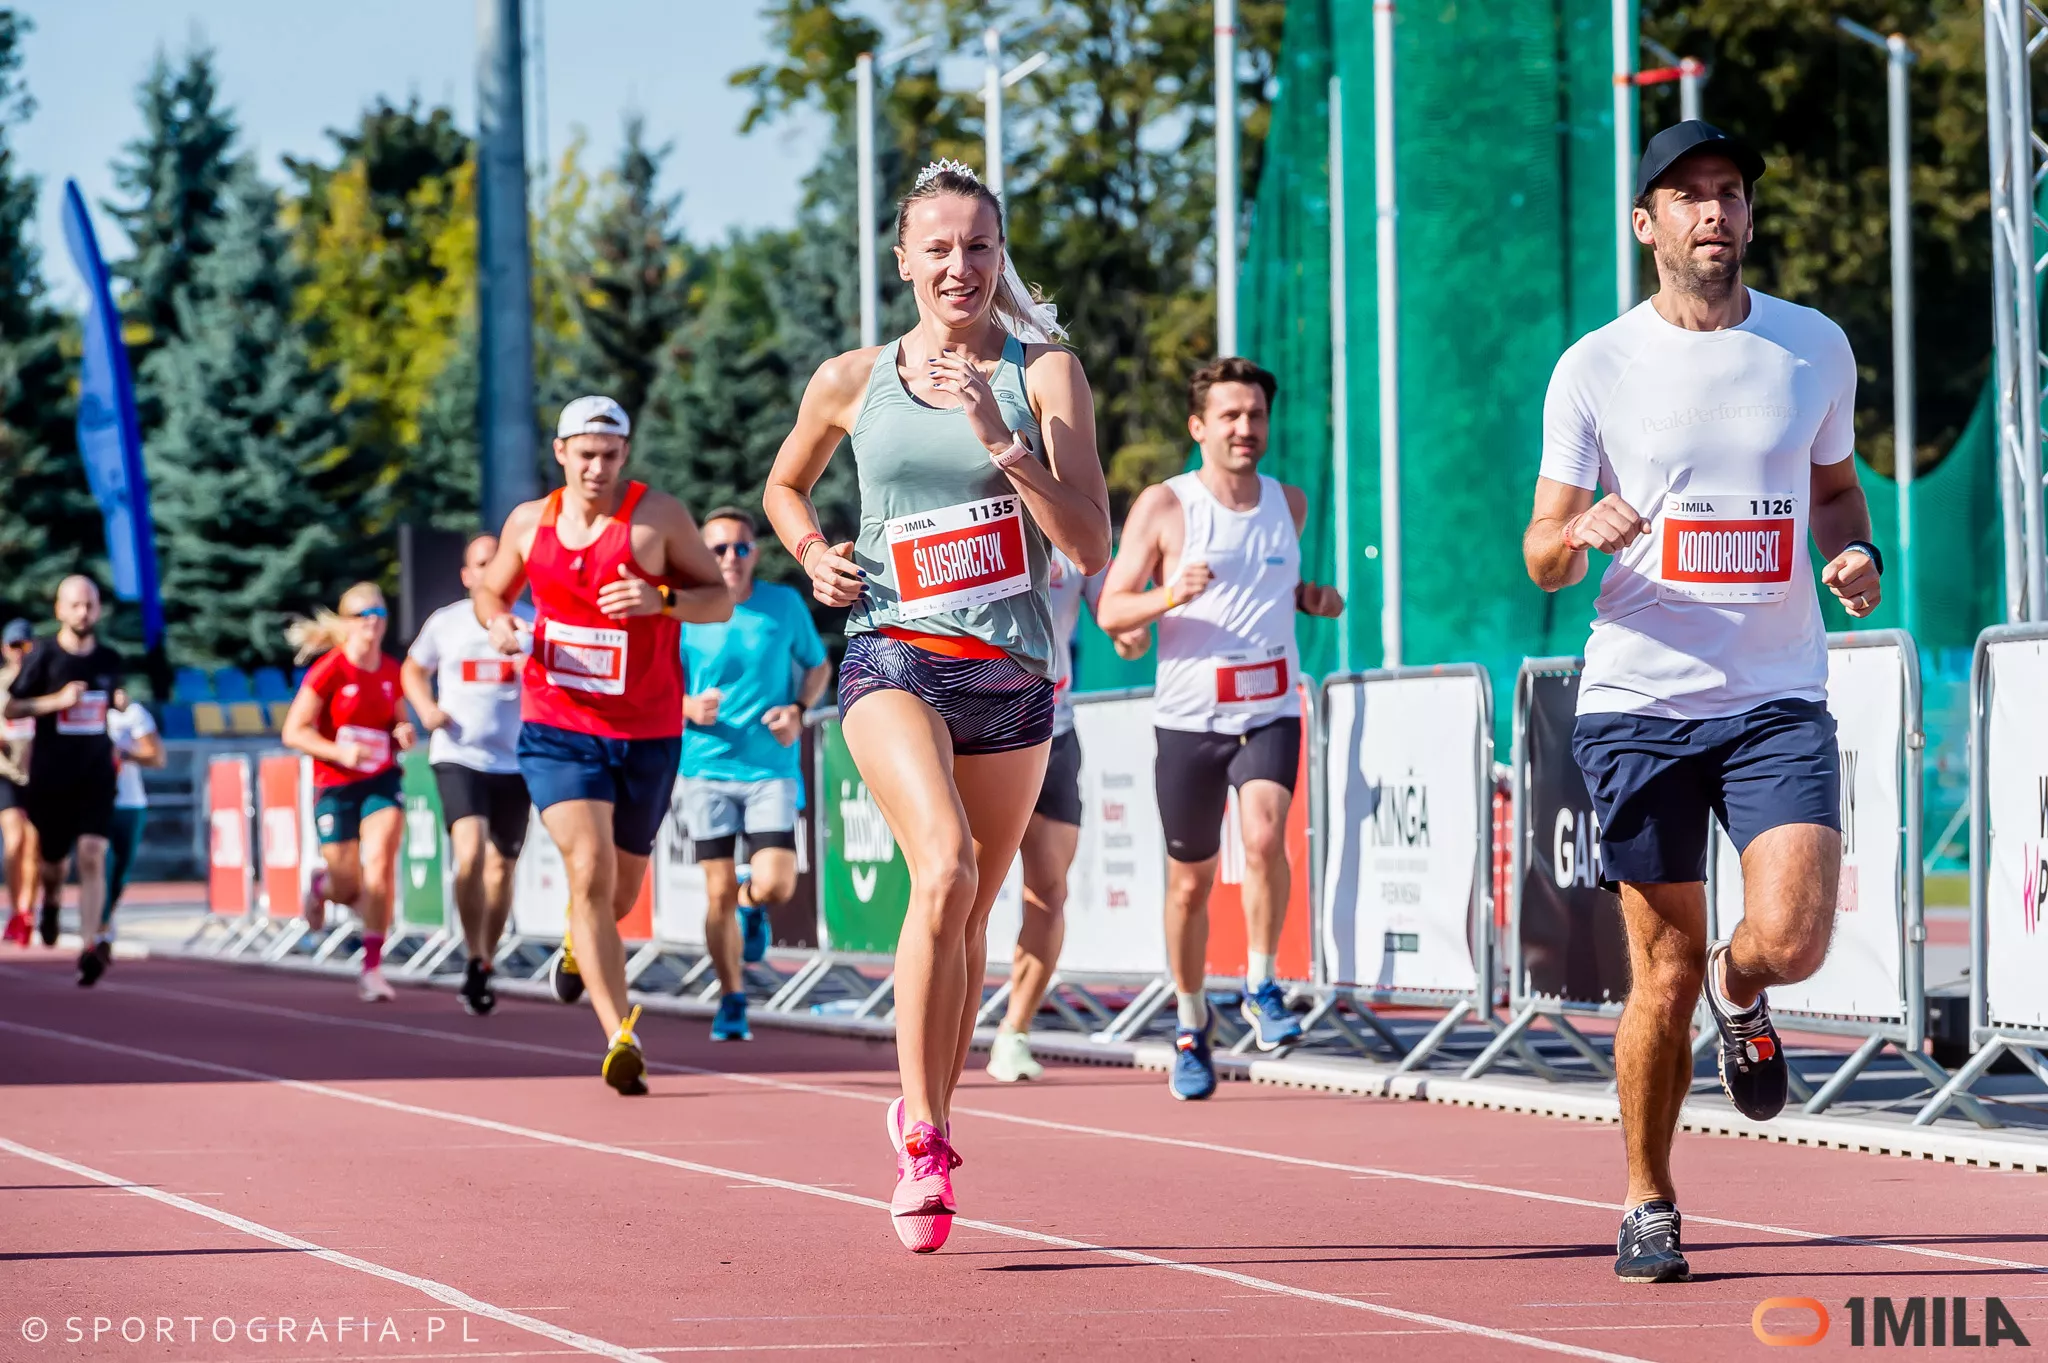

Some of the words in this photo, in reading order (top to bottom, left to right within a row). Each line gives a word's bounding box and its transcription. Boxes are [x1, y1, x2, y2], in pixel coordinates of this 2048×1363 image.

[968, 500, 1014, 521] 1135
[1681, 502, 1715, 513] 1MILA
[1750, 500, 1792, 515] 1126
[904, 518, 936, 532] 1MILA
[912, 531, 1006, 589] ŚLUSARCZYK
[1678, 530, 1780, 573] KOMOROWSKI
[1553, 807, 1604, 889] GAR
